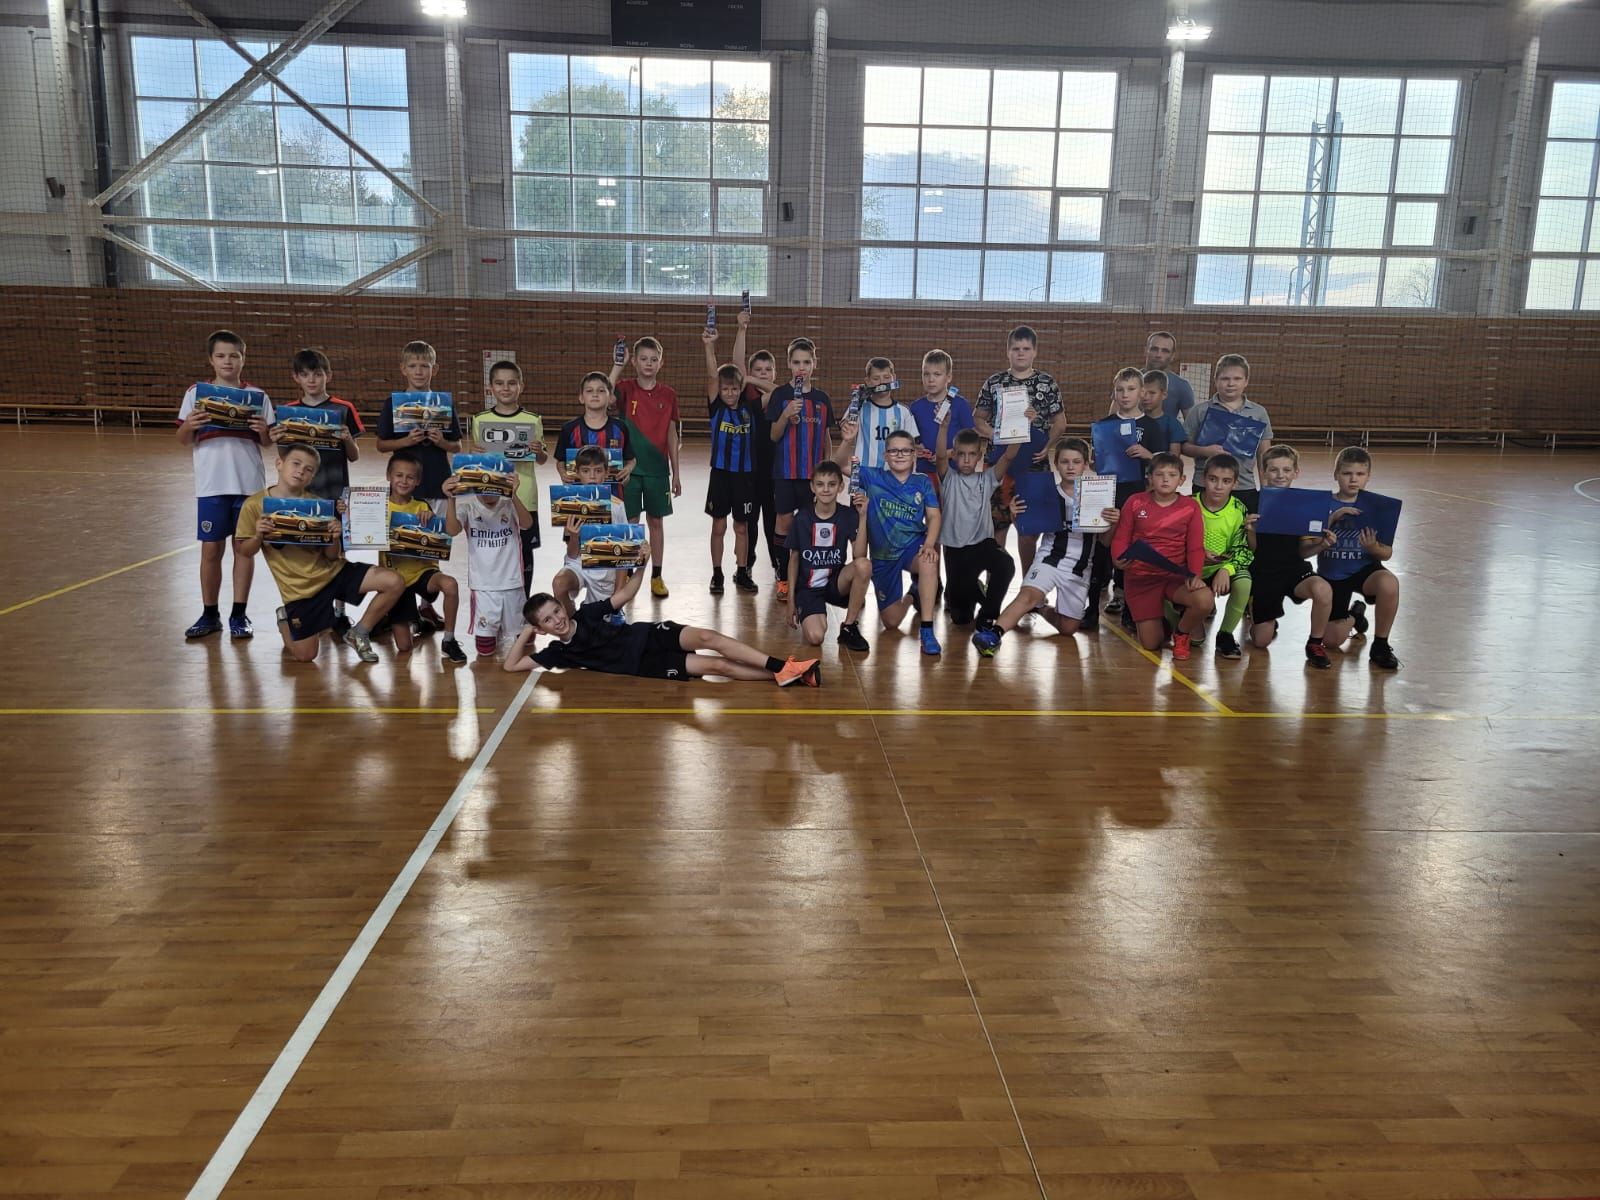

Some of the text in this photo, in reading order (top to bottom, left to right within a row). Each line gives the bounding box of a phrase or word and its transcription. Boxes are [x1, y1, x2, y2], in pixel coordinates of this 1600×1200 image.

[631, 400, 638, 416] 7
[875, 425, 890, 441] 10
[743, 502, 753, 515] 10
[470, 527, 513, 539] Emirates
[477, 538, 487, 548] FLY
[802, 548, 841, 561] QATAR
